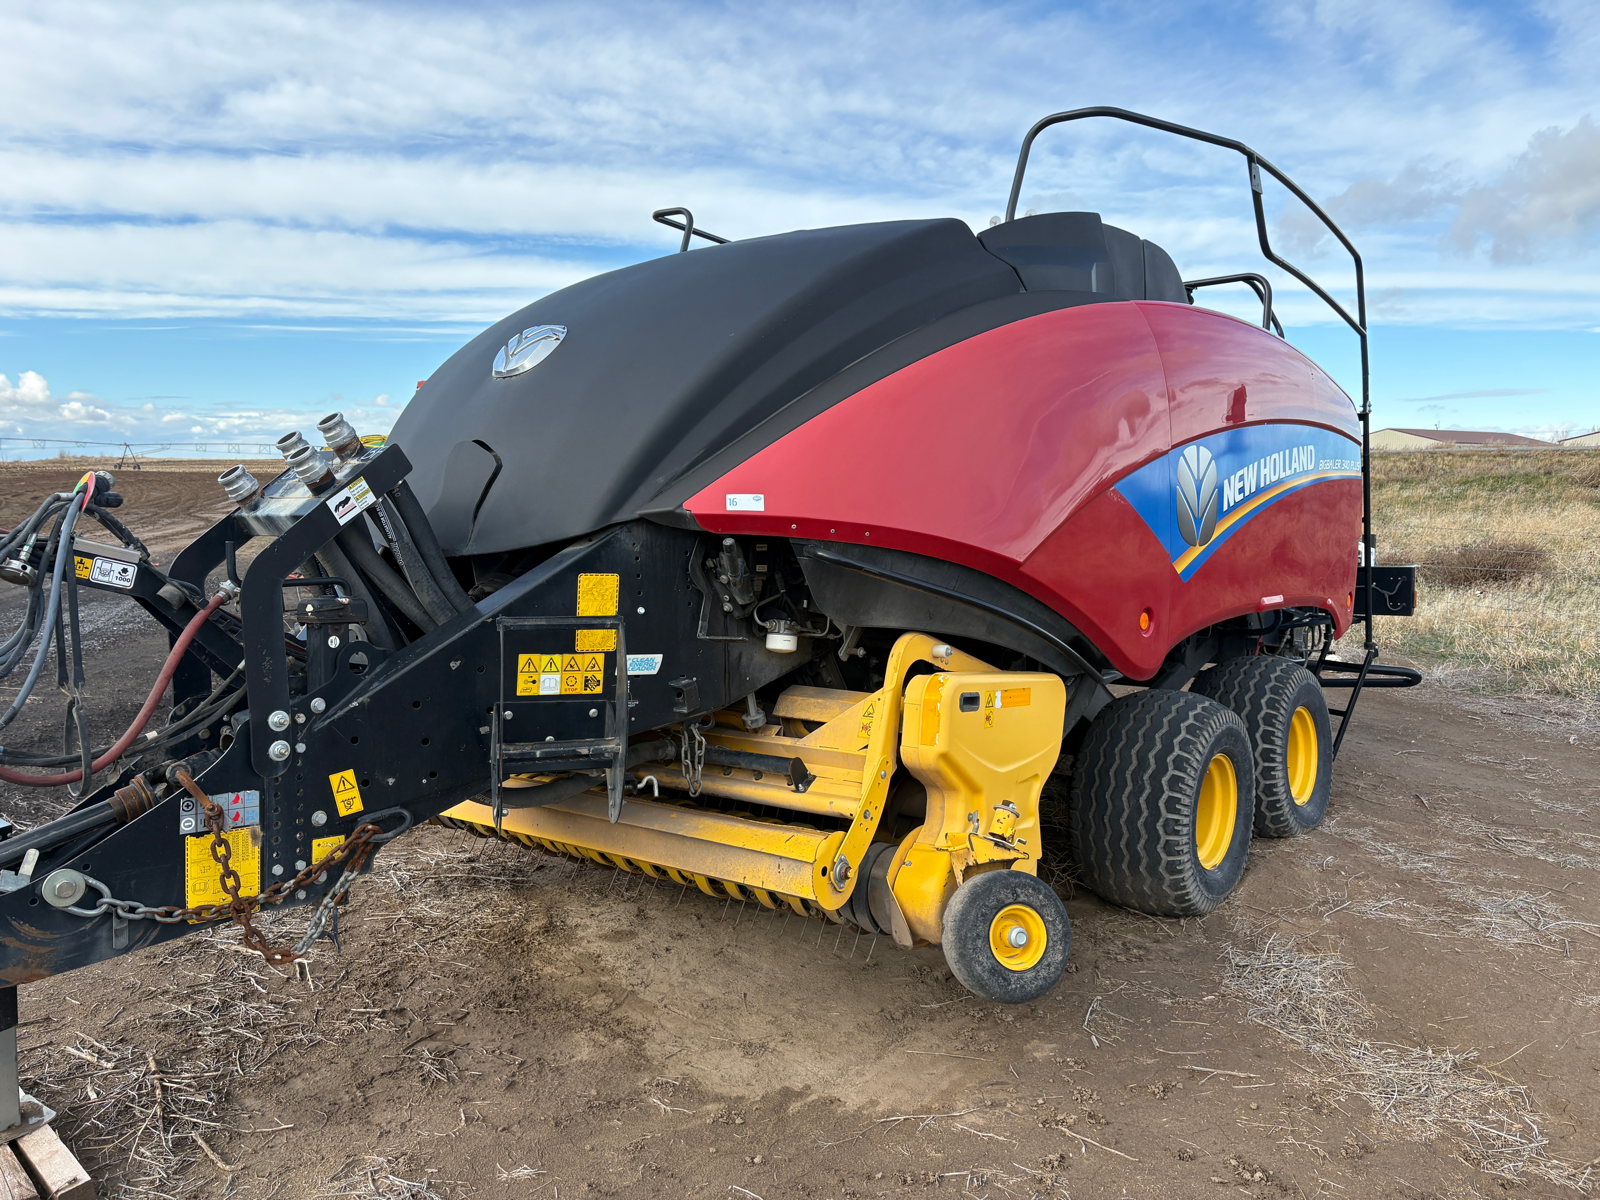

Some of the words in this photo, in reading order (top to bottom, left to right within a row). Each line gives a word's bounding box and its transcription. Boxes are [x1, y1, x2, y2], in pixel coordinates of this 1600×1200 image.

[1319, 459, 1341, 471] BIGBALER
[1341, 459, 1350, 470] 340
[1350, 460, 1361, 471] PLUS
[1223, 461, 1258, 513] NEW
[1260, 445, 1315, 488] HOLLAND
[728, 497, 738, 507] 16
[115, 575, 131, 583] 1000
